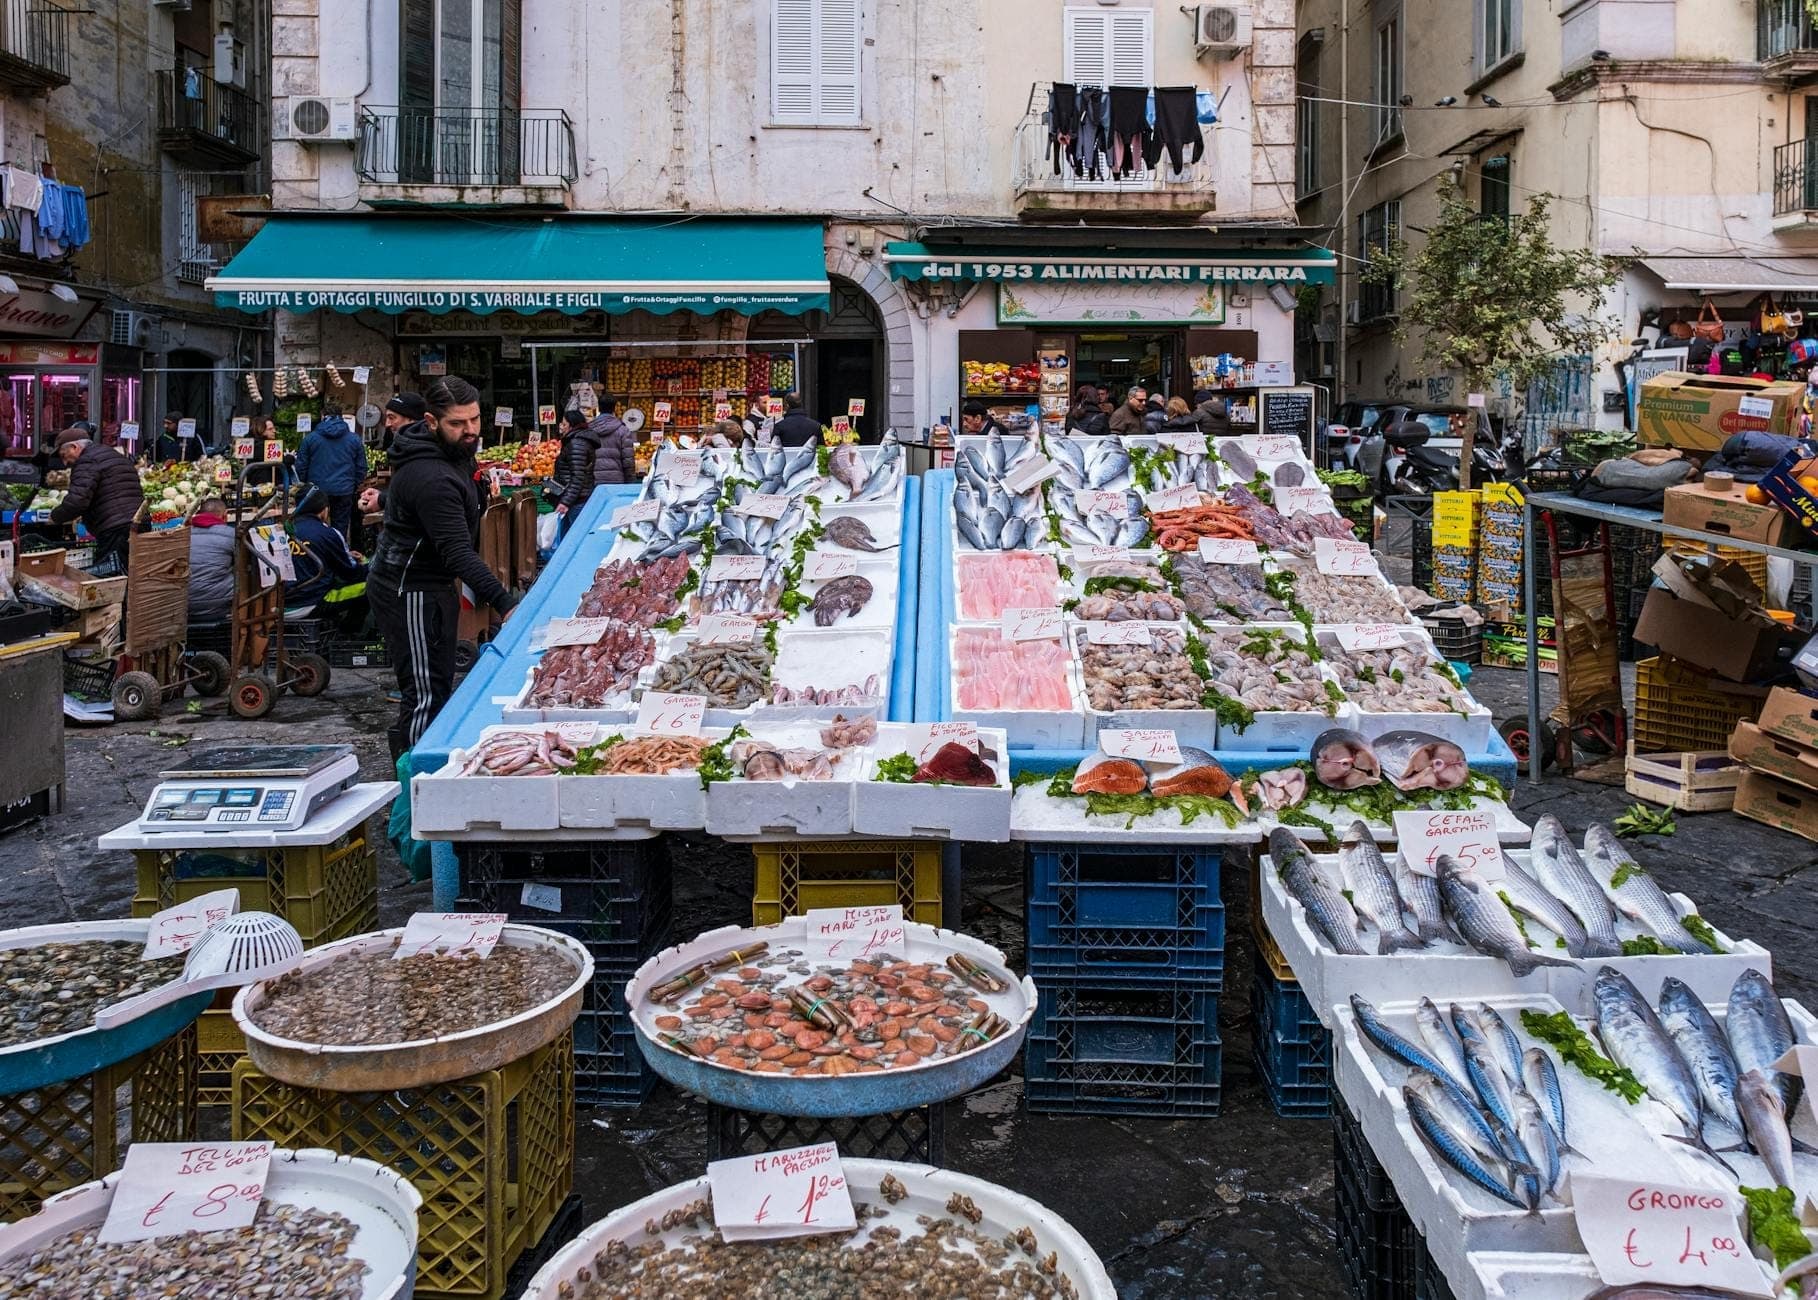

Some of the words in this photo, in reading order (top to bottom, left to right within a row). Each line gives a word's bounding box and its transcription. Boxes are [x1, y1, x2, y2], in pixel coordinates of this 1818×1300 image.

[922, 262, 962, 278] dal
[972, 262, 1034, 279] 1953
[1041, 264, 1191, 280] ALIMENTARI
[1199, 265, 1307, 281] FERRARA
[238, 291, 289, 306] FRUTTA
[295, 291, 303, 306] E
[307, 291, 370, 307] ORTAGGI
[374, 292, 444, 307] FUNGILLO
[450, 292, 466, 307] DI
[470, 293, 482, 307] S.
[484, 293, 551, 307] VARRIALE
[555, 293, 564, 307] E
[567, 293, 602, 307] FIGLI
[1643, 399, 1694, 411] Premium
[1441, 514, 1465, 522] VITTORIA
[1424, 845, 1440, 874] €
[845, 907, 888, 920] MISTO
[828, 939, 845, 958] €
[180, 1144, 268, 1163] TELLINA
[177, 1160, 217, 1176] DEL
[142, 1190, 176, 1227] €
[754, 1193, 772, 1224] €
[1627, 1187, 1725, 1212] GRONGO
[1623, 1227, 1653, 1268] €
